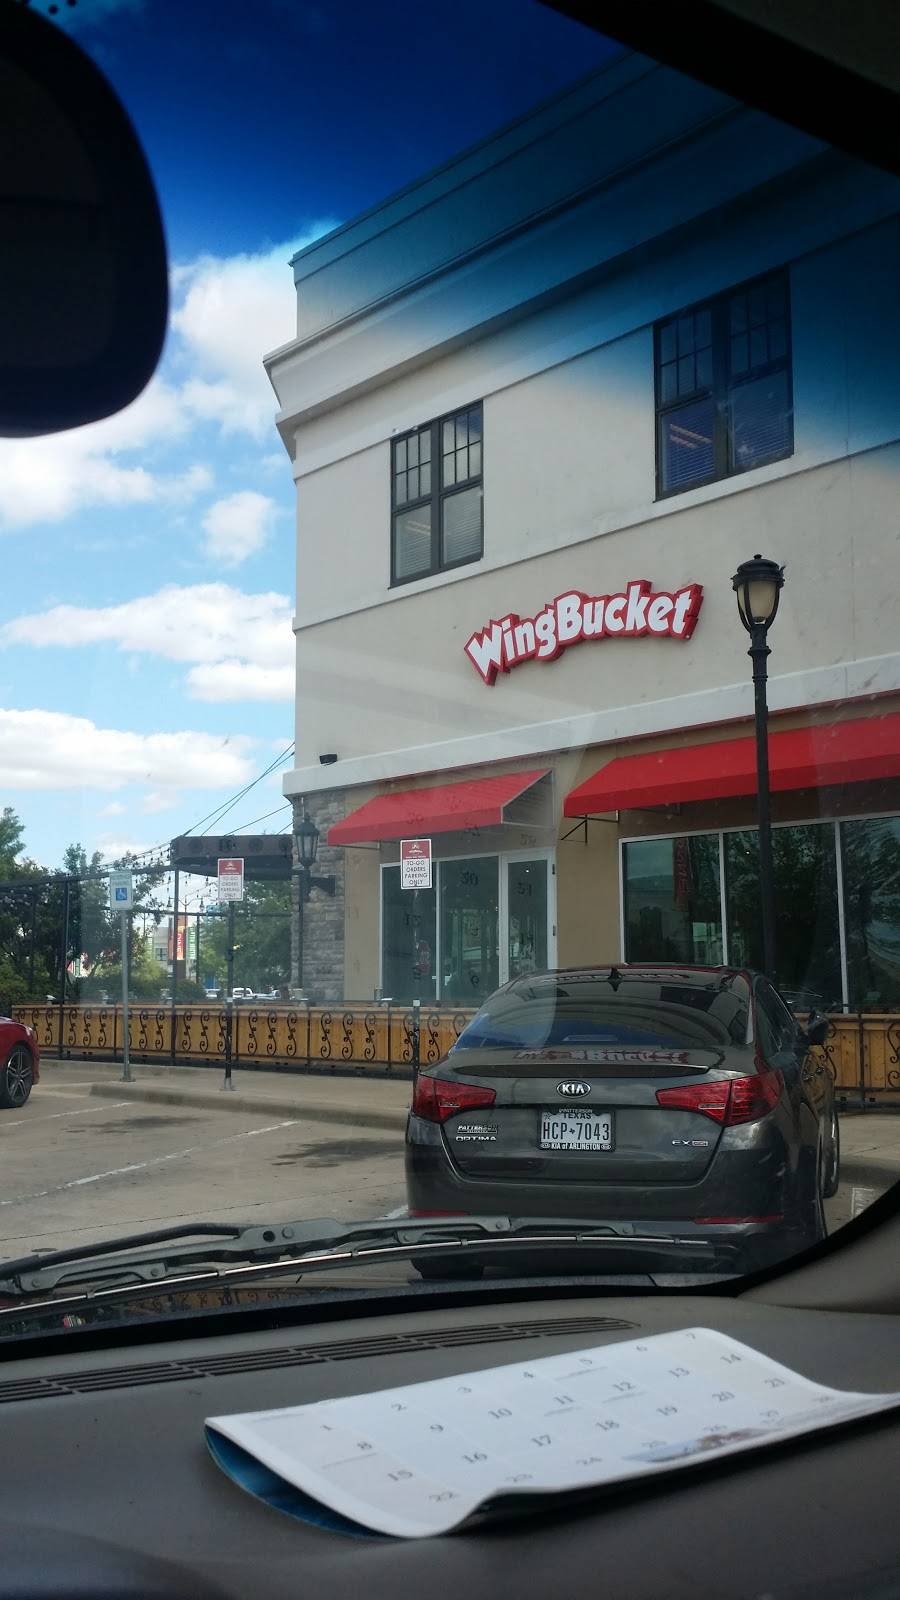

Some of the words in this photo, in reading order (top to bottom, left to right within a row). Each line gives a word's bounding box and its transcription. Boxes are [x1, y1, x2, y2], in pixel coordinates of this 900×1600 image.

[465, 582, 697, 680] WingBucket
[562, 1083, 585, 1094] KIA
[563, 1112, 593, 1120] TEXAS
[356, 1440, 373, 1451] 8
[430, 1423, 444, 1433] 9
[488, 1407, 513, 1420] 10
[553, 1394, 576, 1406] 11
[612, 1381, 637, 1393] 12
[668, 1366, 691, 1379] 13
[720, 1352, 743, 1365] 14
[387, 1469, 414, 1483] 15
[460, 1452, 489, 1465] 16
[530, 1433, 553, 1448] 17
[595, 1418, 621, 1433] 18
[656, 1404, 680, 1417] 19
[710, 1390, 737, 1402] 20
[763, 1376, 787, 1389] 21
